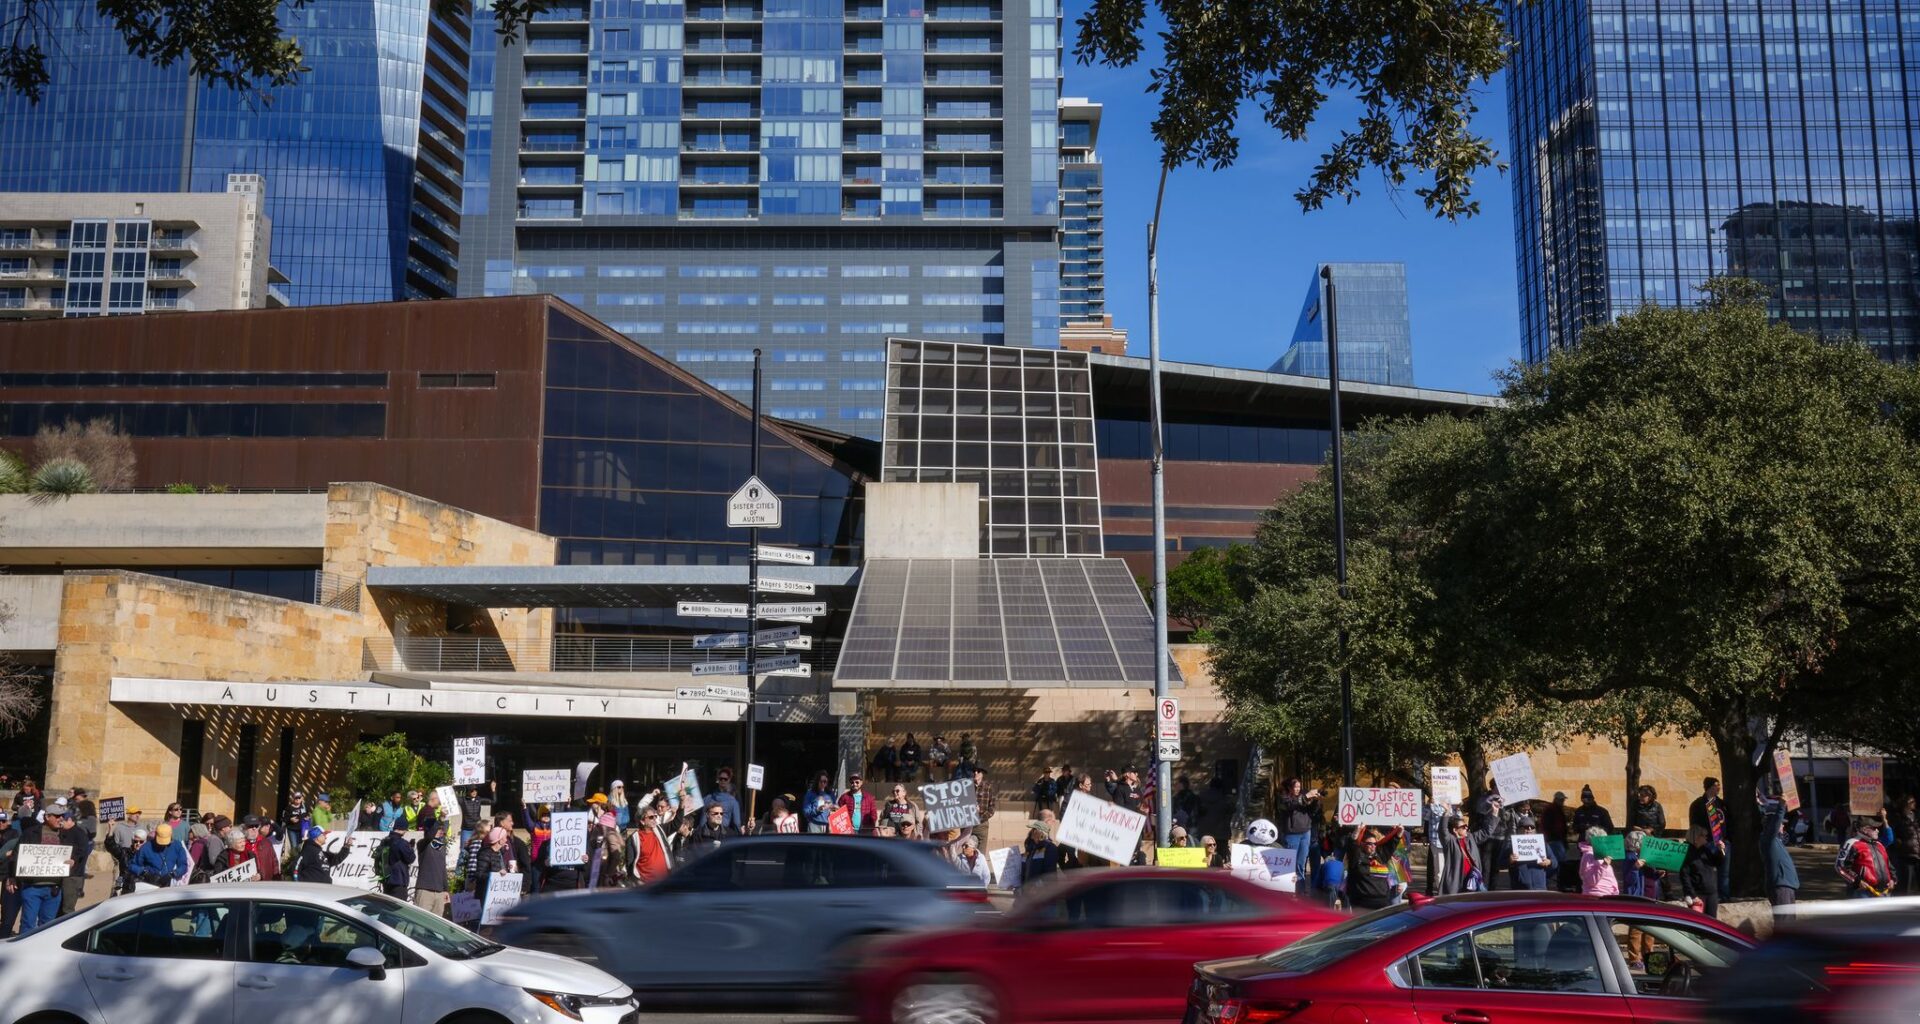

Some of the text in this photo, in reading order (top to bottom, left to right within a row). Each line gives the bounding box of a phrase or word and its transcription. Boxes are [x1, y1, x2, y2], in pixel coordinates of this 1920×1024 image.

[760, 580, 781, 588] Angers
[714, 606, 732, 614] Chiang
[222, 686, 774, 717] AUSTIN CITY HALL
[455, 738, 484, 747] ICE NOT
[458, 747, 480, 755] NEEDED
[525, 782, 540, 791] ICE
[923, 779, 972, 805] STOP
[940, 797, 960, 806] THE
[1344, 788, 1414, 802] NO Justice
[1356, 802, 1418, 817] NO PEACE
[927, 804, 980, 831] MURDER
[1099, 804, 1142, 832] WRONG!
[555, 818, 583, 833] ICE
[554, 835, 582, 847] KILLED
[22, 845, 68, 856] PROSECUTE
[555, 848, 580, 863] GOOD
[33, 856, 56, 865] ICE
[1241, 850, 1291, 867] ABOLISH
[18, 866, 65, 876] MURDERERS
[1248, 868, 1281, 882] ICE
[490, 879, 520, 893] VETERAN
